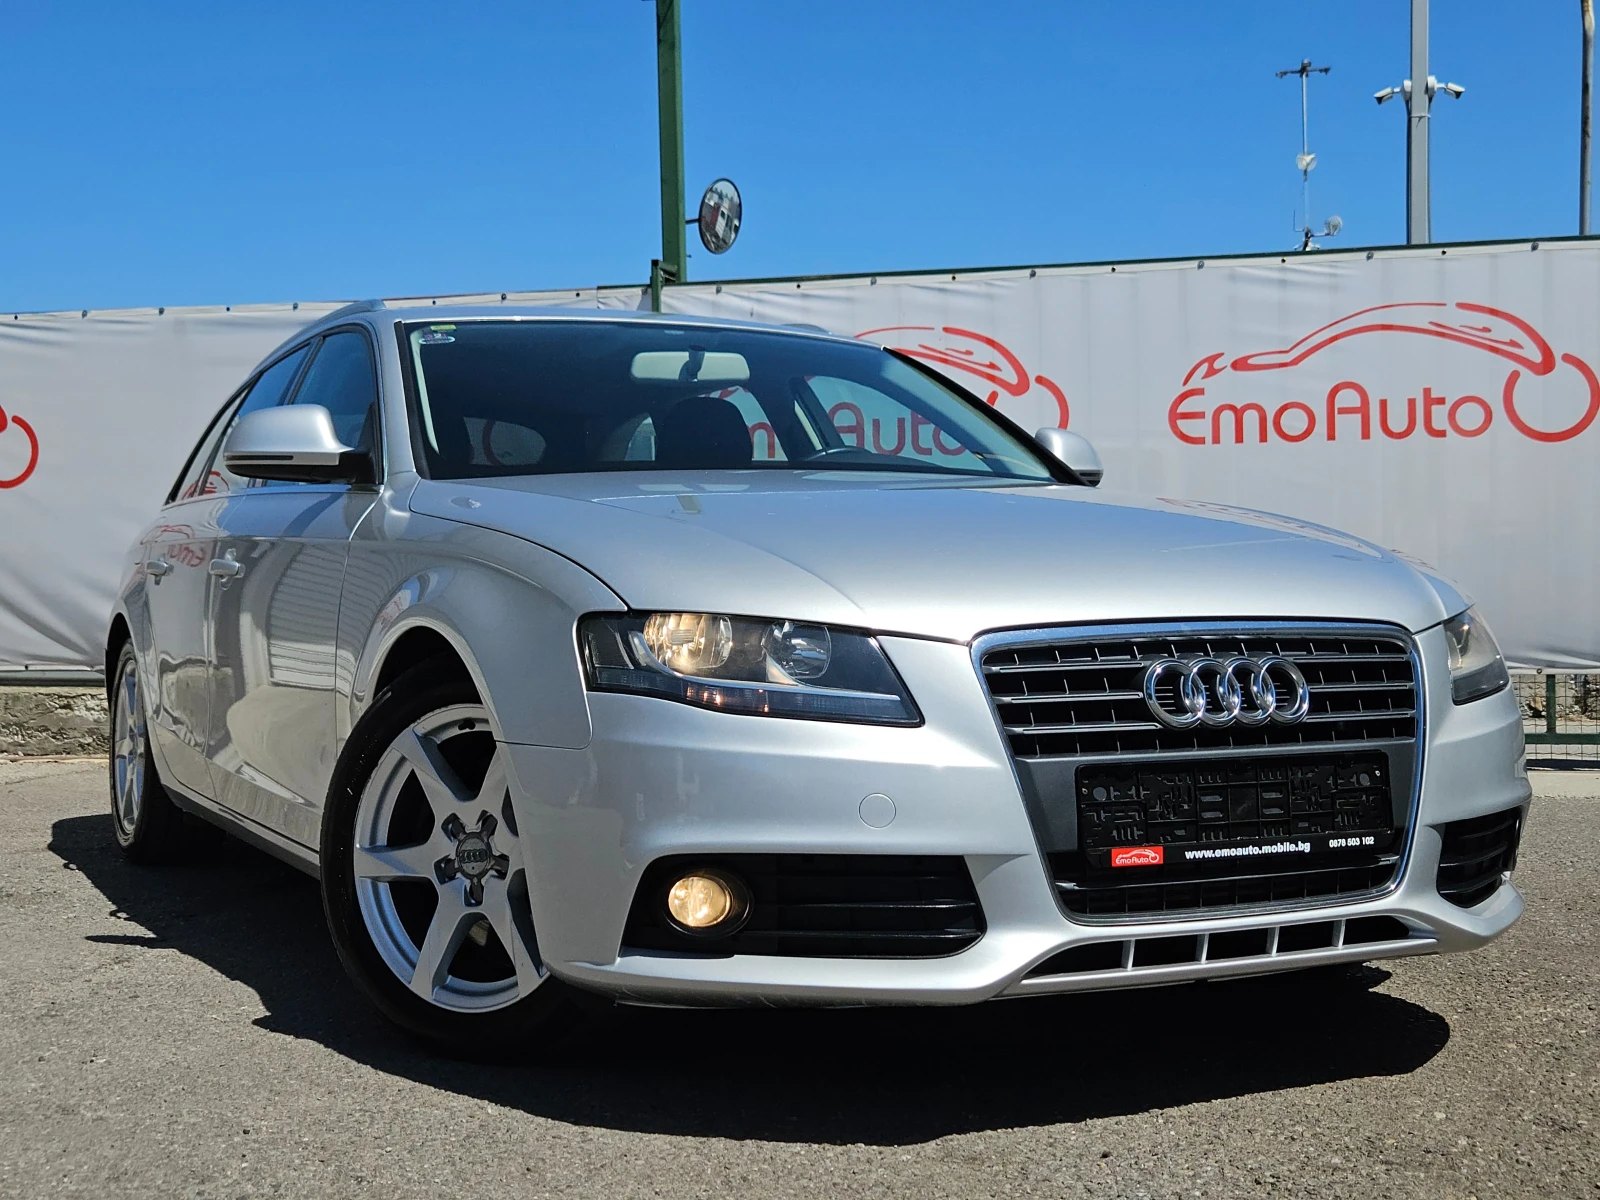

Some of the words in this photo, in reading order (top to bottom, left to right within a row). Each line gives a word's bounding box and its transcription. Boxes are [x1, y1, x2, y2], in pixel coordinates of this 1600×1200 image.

[1168, 381, 1493, 445] EmoAuto
[1361, 836, 1375, 846] 102
[1185, 841, 1311, 860] www.emoauto.mobile.bg
[1115, 856, 1149, 865] EmoAuto
